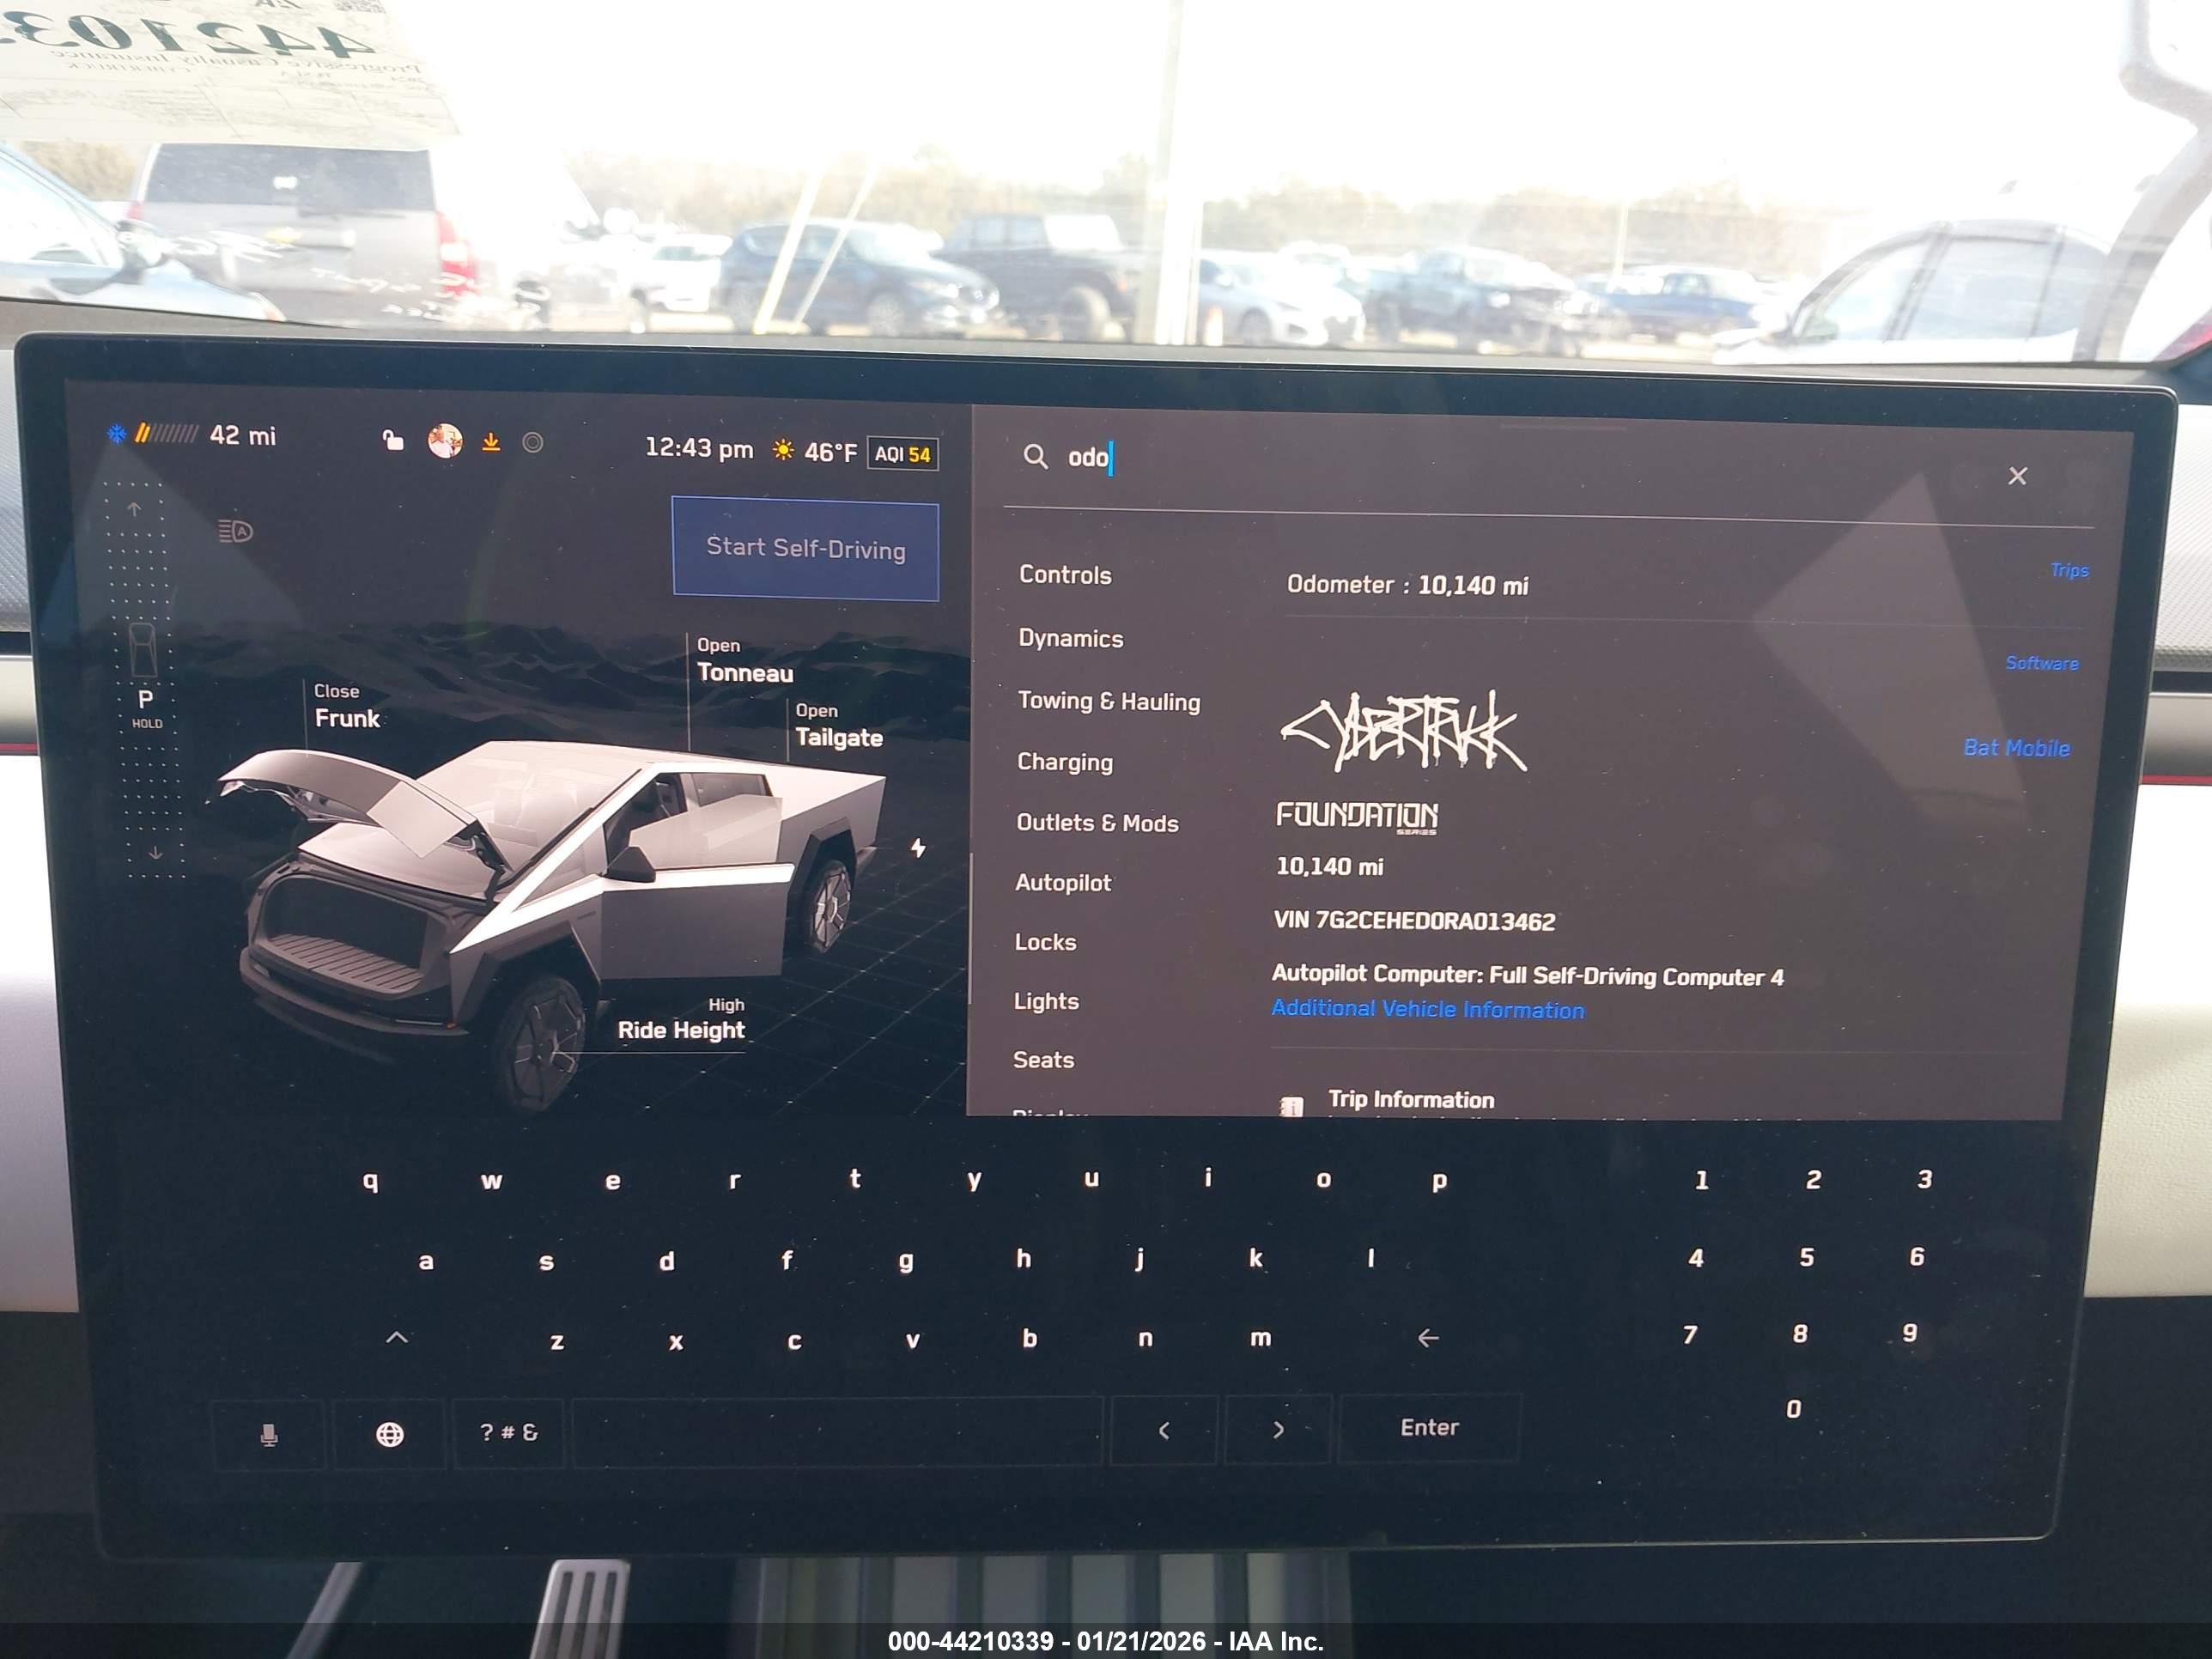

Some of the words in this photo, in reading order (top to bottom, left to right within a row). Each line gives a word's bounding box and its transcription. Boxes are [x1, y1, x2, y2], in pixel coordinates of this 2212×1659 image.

[210, 424, 240, 445] 42
[249, 426, 276, 446] mi
[646, 436, 712, 458] 12:43
[719, 443, 754, 463] pm
[804, 442, 858, 463] 46°F
[874, 446, 904, 464] AQI
[908, 447, 931, 463] 54
[1068, 447, 1109, 467] odo
[707, 536, 766, 556] Start
[774, 538, 906, 565] Self-Driving
[1020, 563, 1112, 585] Controls
[2051, 562, 2089, 580] Trips
[1287, 574, 1395, 594] Odometer
[1419, 574, 1496, 598] 10,140
[1503, 576, 1529, 596] mi
[697, 637, 741, 655] Open
[1019, 627, 1124, 652] Dynamics
[696, 661, 794, 684] Tonneau
[2006, 654, 2080, 672] Software
[138, 690, 154, 709] P
[314, 683, 360, 698] Close
[796, 702, 838, 720] Open
[1018, 690, 1093, 714] Towing
[1100, 691, 1115, 710] &
[1121, 691, 1201, 716] Hauling
[132, 718, 163, 729] HOLD
[315, 708, 381, 728] Frunk
[795, 726, 884, 751] Tailgate
[1964, 738, 2000, 757] Bat
[2005, 738, 2071, 758] Mobile
[1018, 751, 1114, 776] Charging
[1017, 812, 1095, 832] Outlets
[1102, 813, 1117, 832] &
[1123, 814, 1179, 833] Mods
[1276, 801, 1439, 829] FOUNDATION
[1277, 856, 1352, 878] 10,140
[1358, 857, 1384, 876] mi
[1015, 872, 1113, 896] Autopilot
[1273, 909, 1310, 928] VIN
[1015, 933, 1077, 951] Locks
[1271, 963, 1369, 986] Autopilot
[1373, 963, 1484, 988] Computer:
[1489, 965, 1528, 984] Full
[1533, 965, 1657, 990] Self-Driving
[1662, 967, 1766, 990] Computer
[1770, 969, 1785, 987] 4
[708, 998, 745, 1014] High
[1014, 992, 1079, 1014] Lights
[1271, 998, 1376, 1017] Additional
[1382, 1000, 1457, 1018] Vehicle
[1463, 1000, 1585, 1019] Information
[618, 1020, 667, 1039] Ride
[674, 1020, 746, 1043] Height
[1013, 1050, 1075, 1069] Seats
[1328, 1089, 1369, 1112] Trip
[1374, 1090, 1495, 1109] Information
[362, 1173, 379, 1194] q
[480, 1174, 503, 1190] w
[605, 1174, 621, 1190] e
[730, 1174, 742, 1189] r
[849, 1168, 861, 1188] t
[967, 1171, 982, 1193] y
[1085, 1171, 1099, 1188] u
[1205, 1167, 1212, 1188] i
[1316, 1172, 1332, 1188] o
[1432, 1173, 1448, 1194] p
[1695, 1170, 1710, 1190] 1
[1806, 1170, 1822, 1189] 2
[1917, 1169, 1933, 1189] 3
[419, 1255, 434, 1270] a
[539, 1255, 555, 1271] s
[659, 1250, 675, 1271] d
[781, 1249, 794, 1270] f
[899, 1253, 914, 1274] g
[1017, 1248, 1031, 1268] h
[1134, 1247, 1144, 1273] j
[1249, 1247, 1263, 1267] k
[1368, 1248, 1375, 1268] l
[1688, 1248, 1705, 1267] 4
[1800, 1247, 1814, 1267] 5
[1910, 1247, 1925, 1267] 6
[550, 1334, 565, 1351] z
[669, 1334, 684, 1351] x
[787, 1334, 802, 1350] c
[906, 1334, 921, 1349] v
[1023, 1328, 1037, 1348] b
[1139, 1331, 1153, 1347] n
[1250, 1331, 1272, 1346] m
[1683, 1325, 1698, 1345] 7
[1793, 1324, 1808, 1343] 8
[1903, 1323, 1917, 1343] 9
[1786, 1399, 1802, 1419] 0
[1401, 1418, 1461, 1437] Enter
